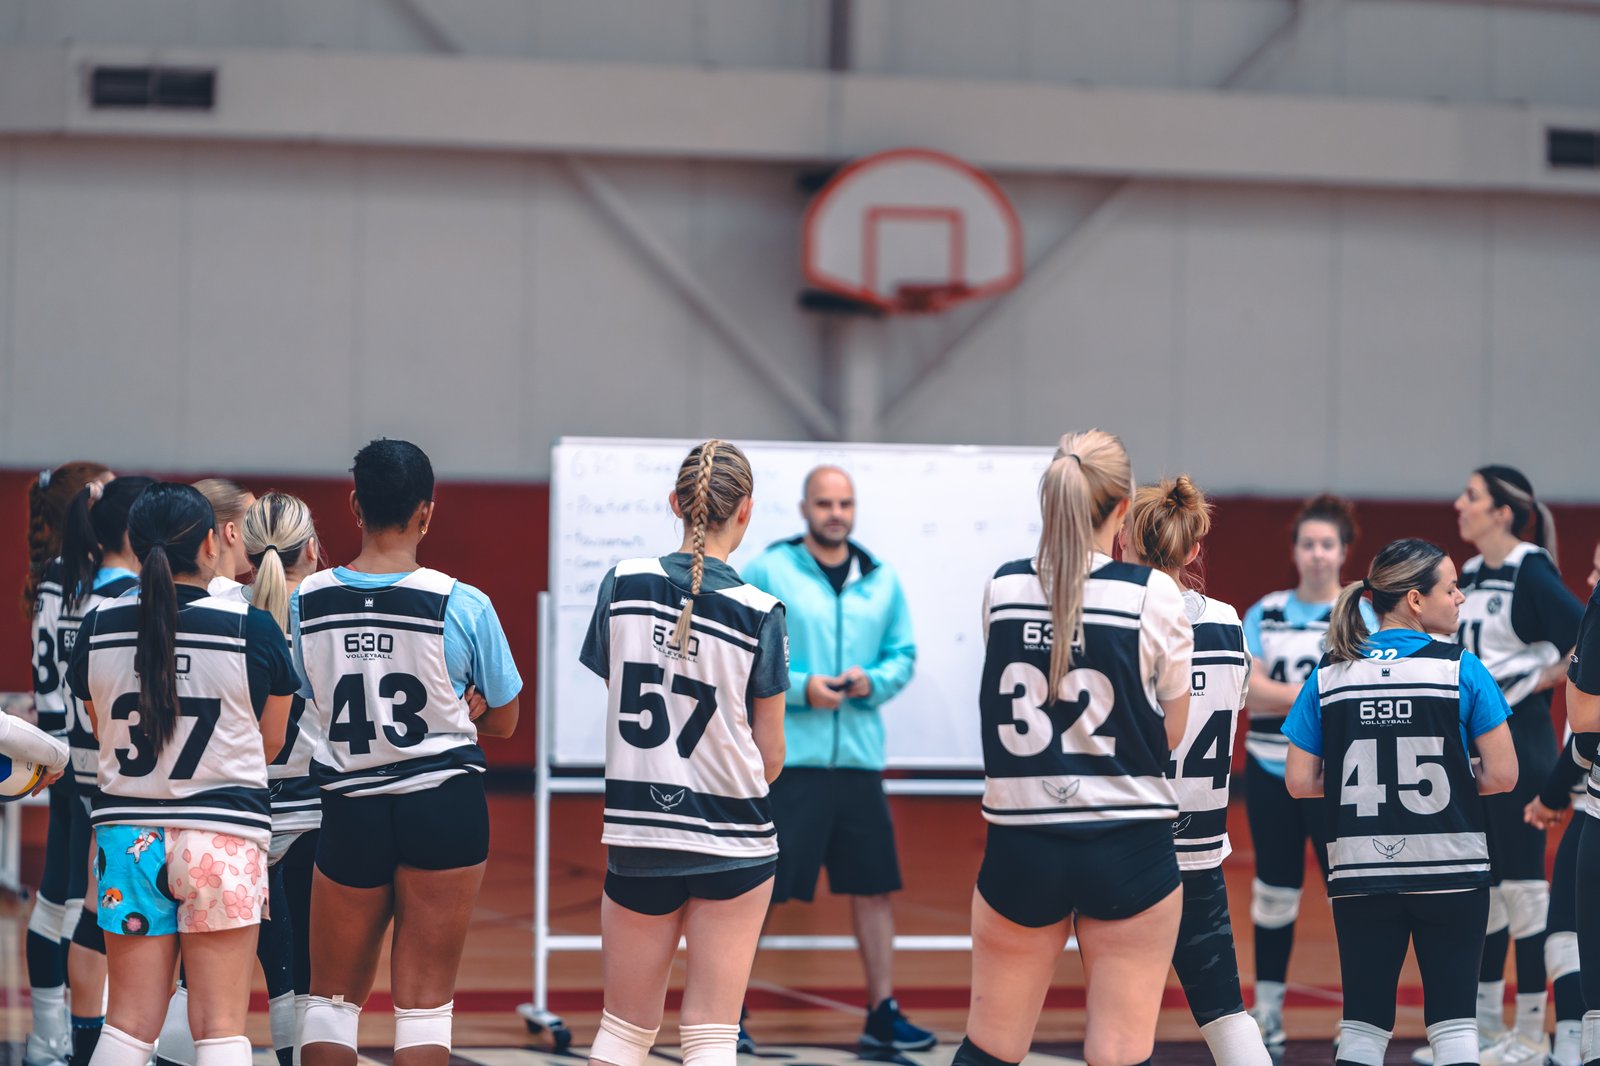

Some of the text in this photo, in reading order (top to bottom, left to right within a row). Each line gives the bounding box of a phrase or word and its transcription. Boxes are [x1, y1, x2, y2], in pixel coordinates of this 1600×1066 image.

[64, 630, 79, 648] 63
[344, 633, 394, 653] 630
[111, 692, 222, 780] 37
[328, 672, 429, 755] 43
[618, 661, 718, 759] 57
[997, 661, 1117, 758] 32
[1360, 699, 1413, 720] 630
[1340, 736, 1451, 818] 45
